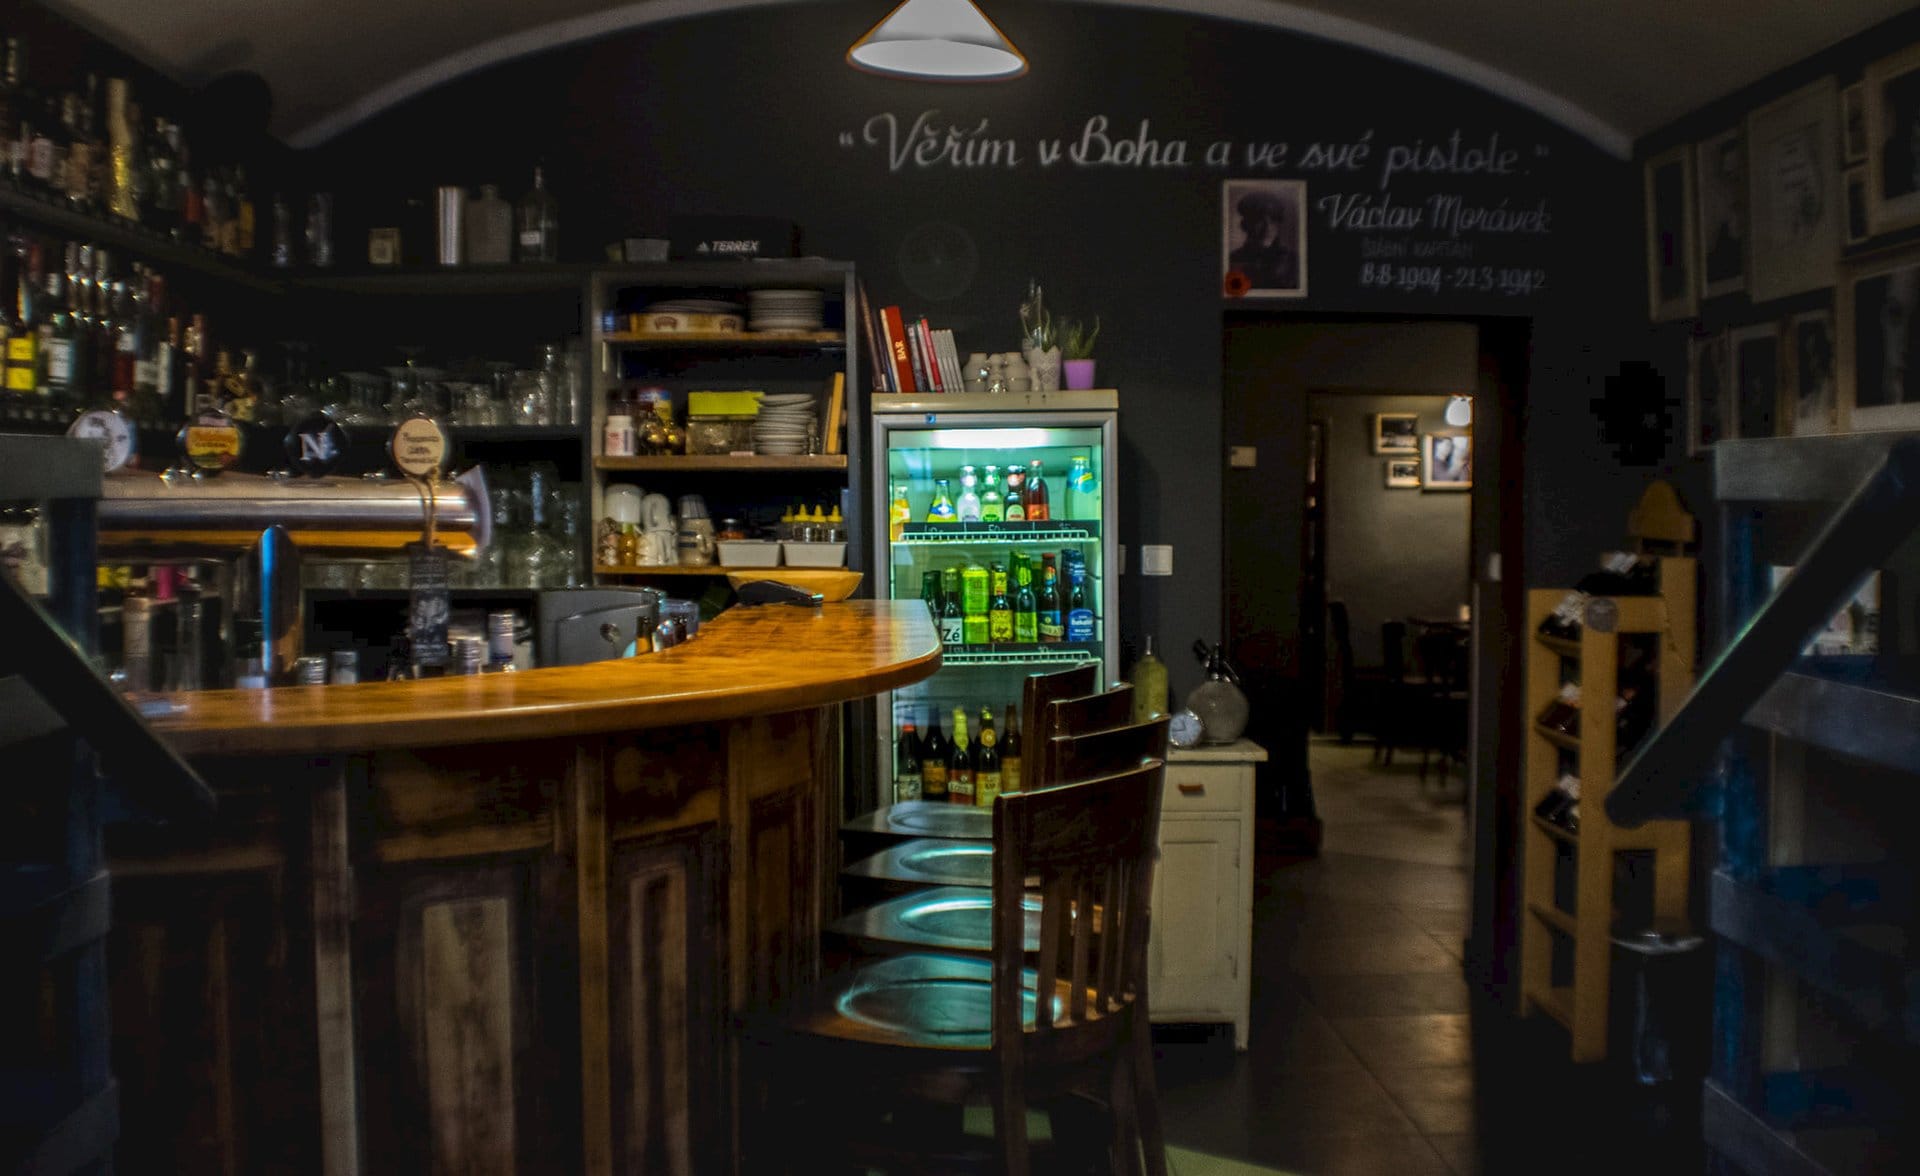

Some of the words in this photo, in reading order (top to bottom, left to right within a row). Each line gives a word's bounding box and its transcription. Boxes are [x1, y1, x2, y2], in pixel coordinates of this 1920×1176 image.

[1038, 138, 1061, 166] v
[1069, 114, 1190, 167] Boha
[1206, 141, 1232, 167] a
[1246, 142, 1288, 168] ve
[1298, 128, 1374, 169] své
[1318, 192, 1423, 230] Václav
[1427, 194, 1551, 237] Morávek
[712, 240, 760, 252] TERREX
